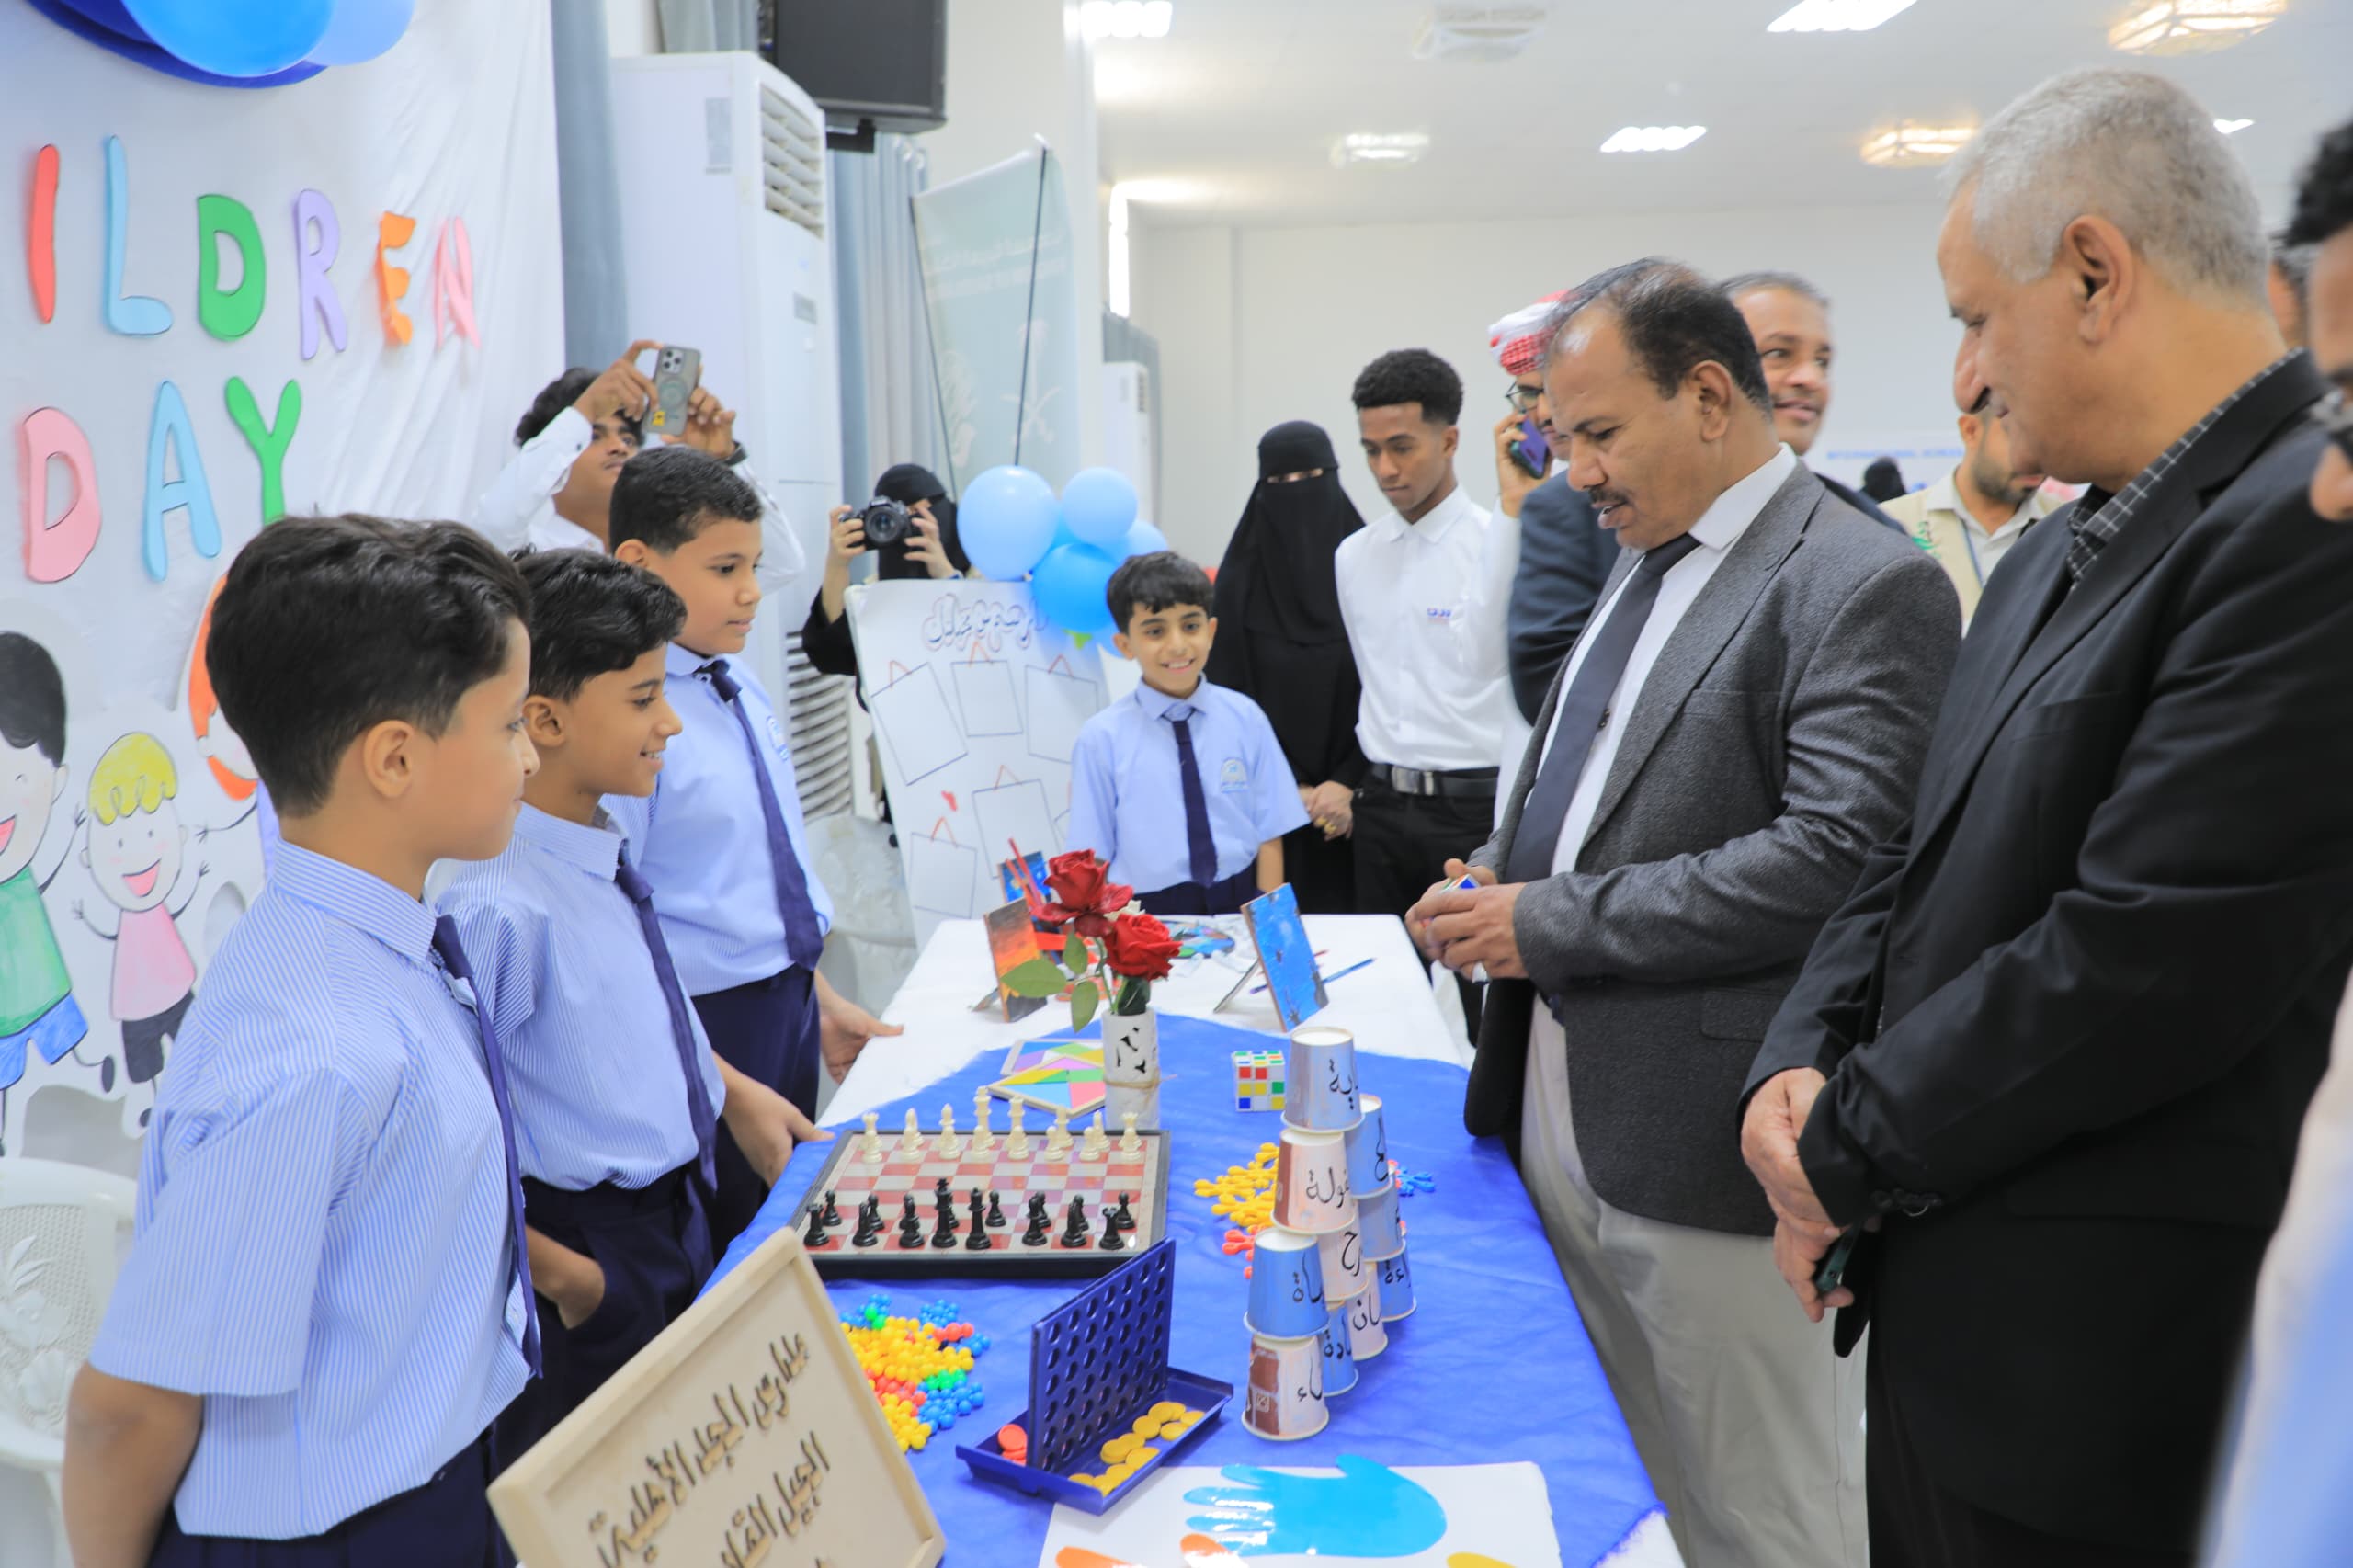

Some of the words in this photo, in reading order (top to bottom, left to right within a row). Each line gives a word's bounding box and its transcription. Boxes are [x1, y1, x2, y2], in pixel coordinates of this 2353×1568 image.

[28, 135, 481, 360] ILDREN
[20, 375, 302, 583] DAY
[773, 1429, 831, 1540] الجيل
